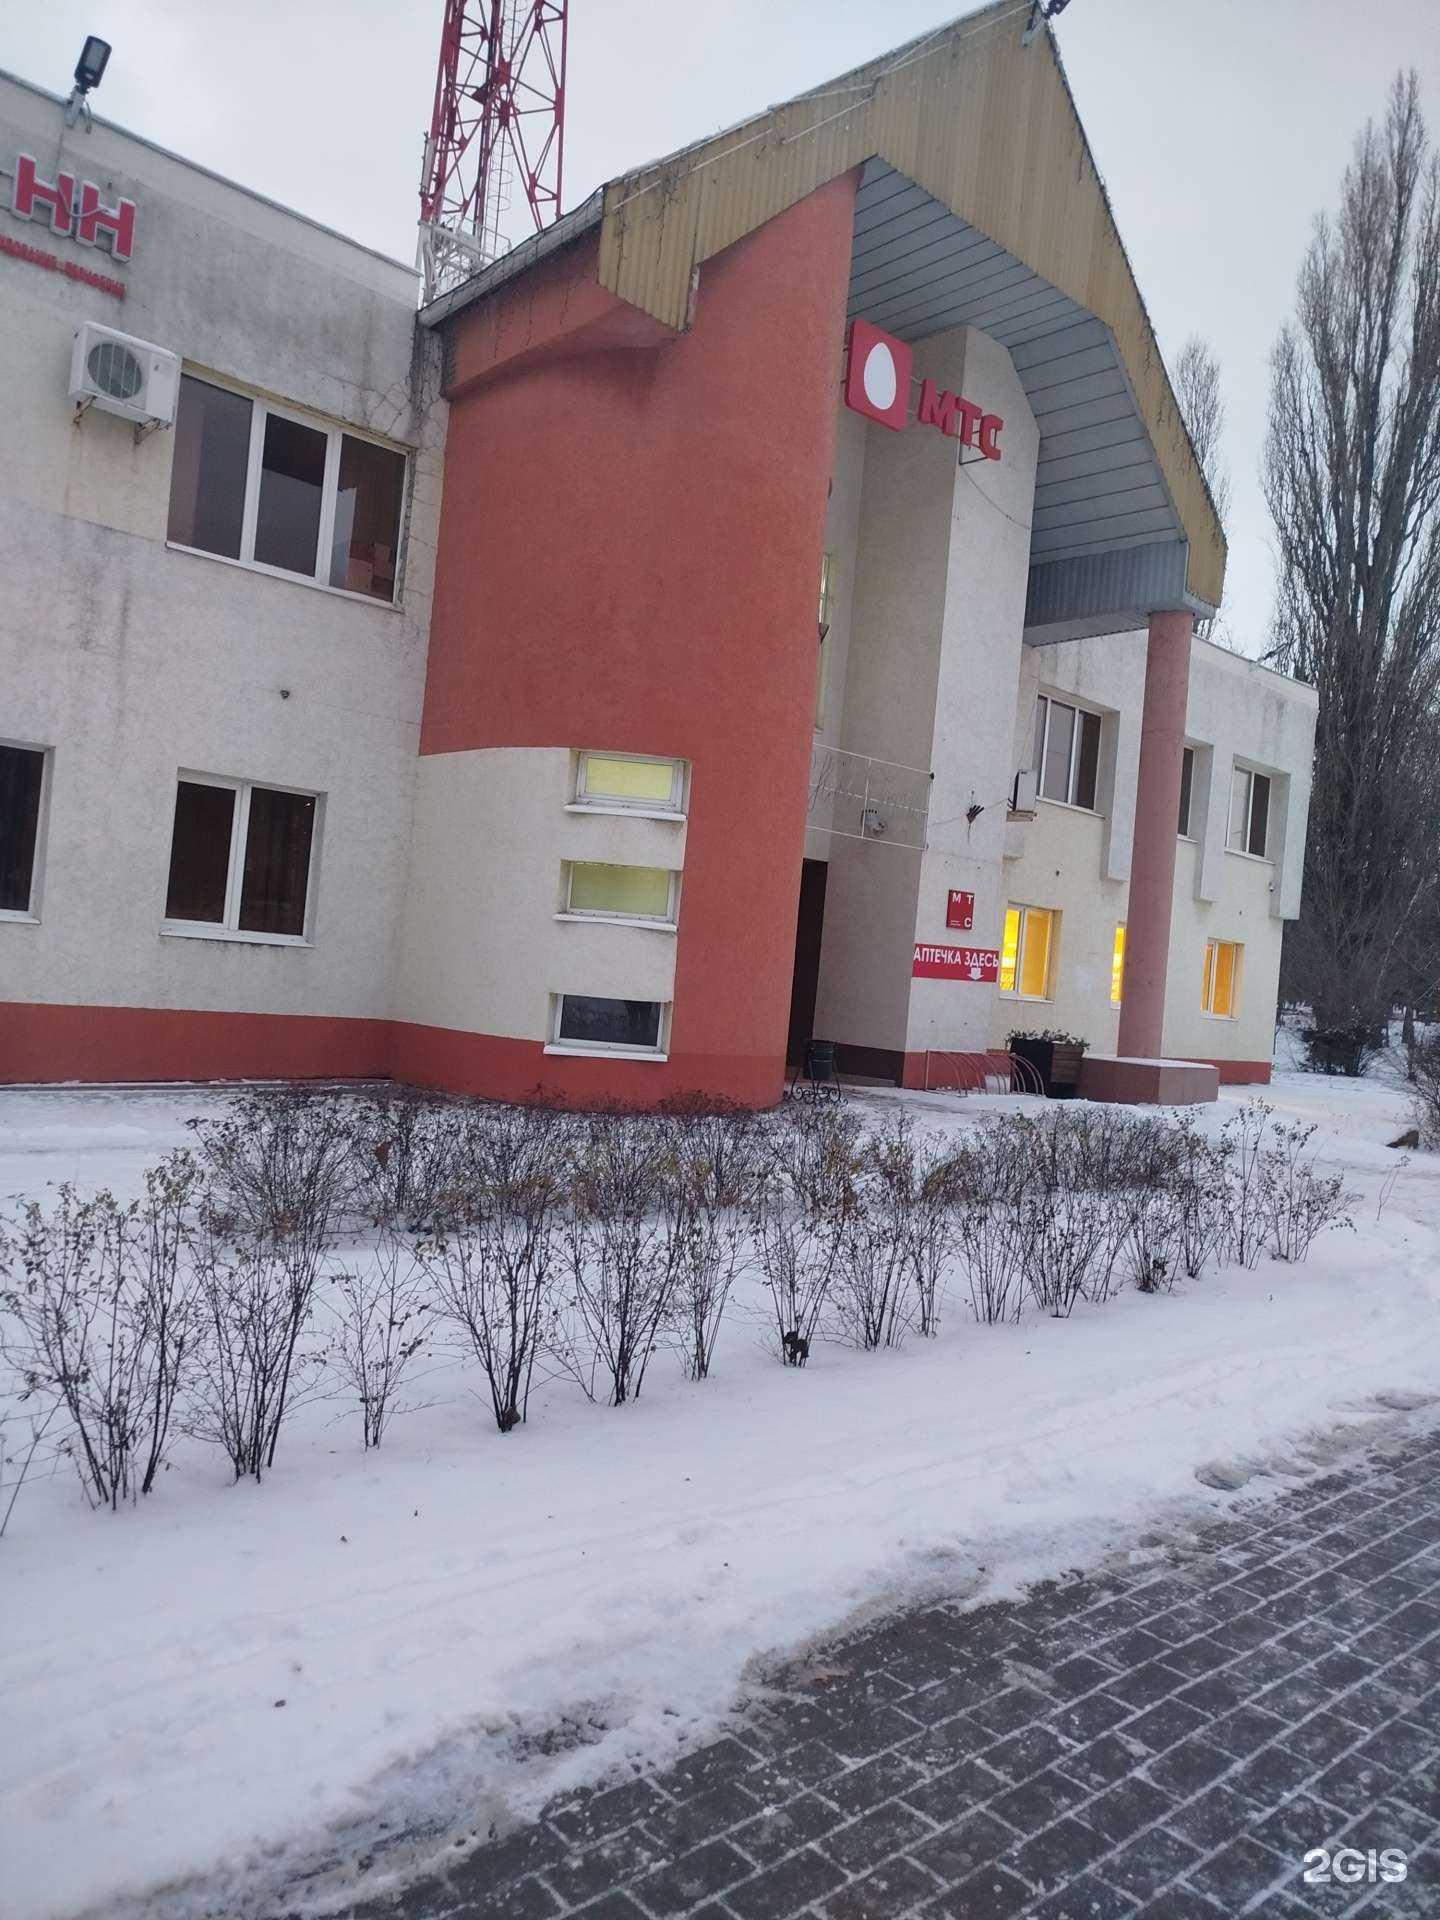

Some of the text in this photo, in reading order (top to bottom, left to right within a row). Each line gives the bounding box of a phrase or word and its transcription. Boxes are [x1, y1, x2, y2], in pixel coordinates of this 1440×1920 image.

[918, 378, 1004, 461] МТС
[913, 947, 999, 968] АПТЕЧКА ЗДЕСЬ
